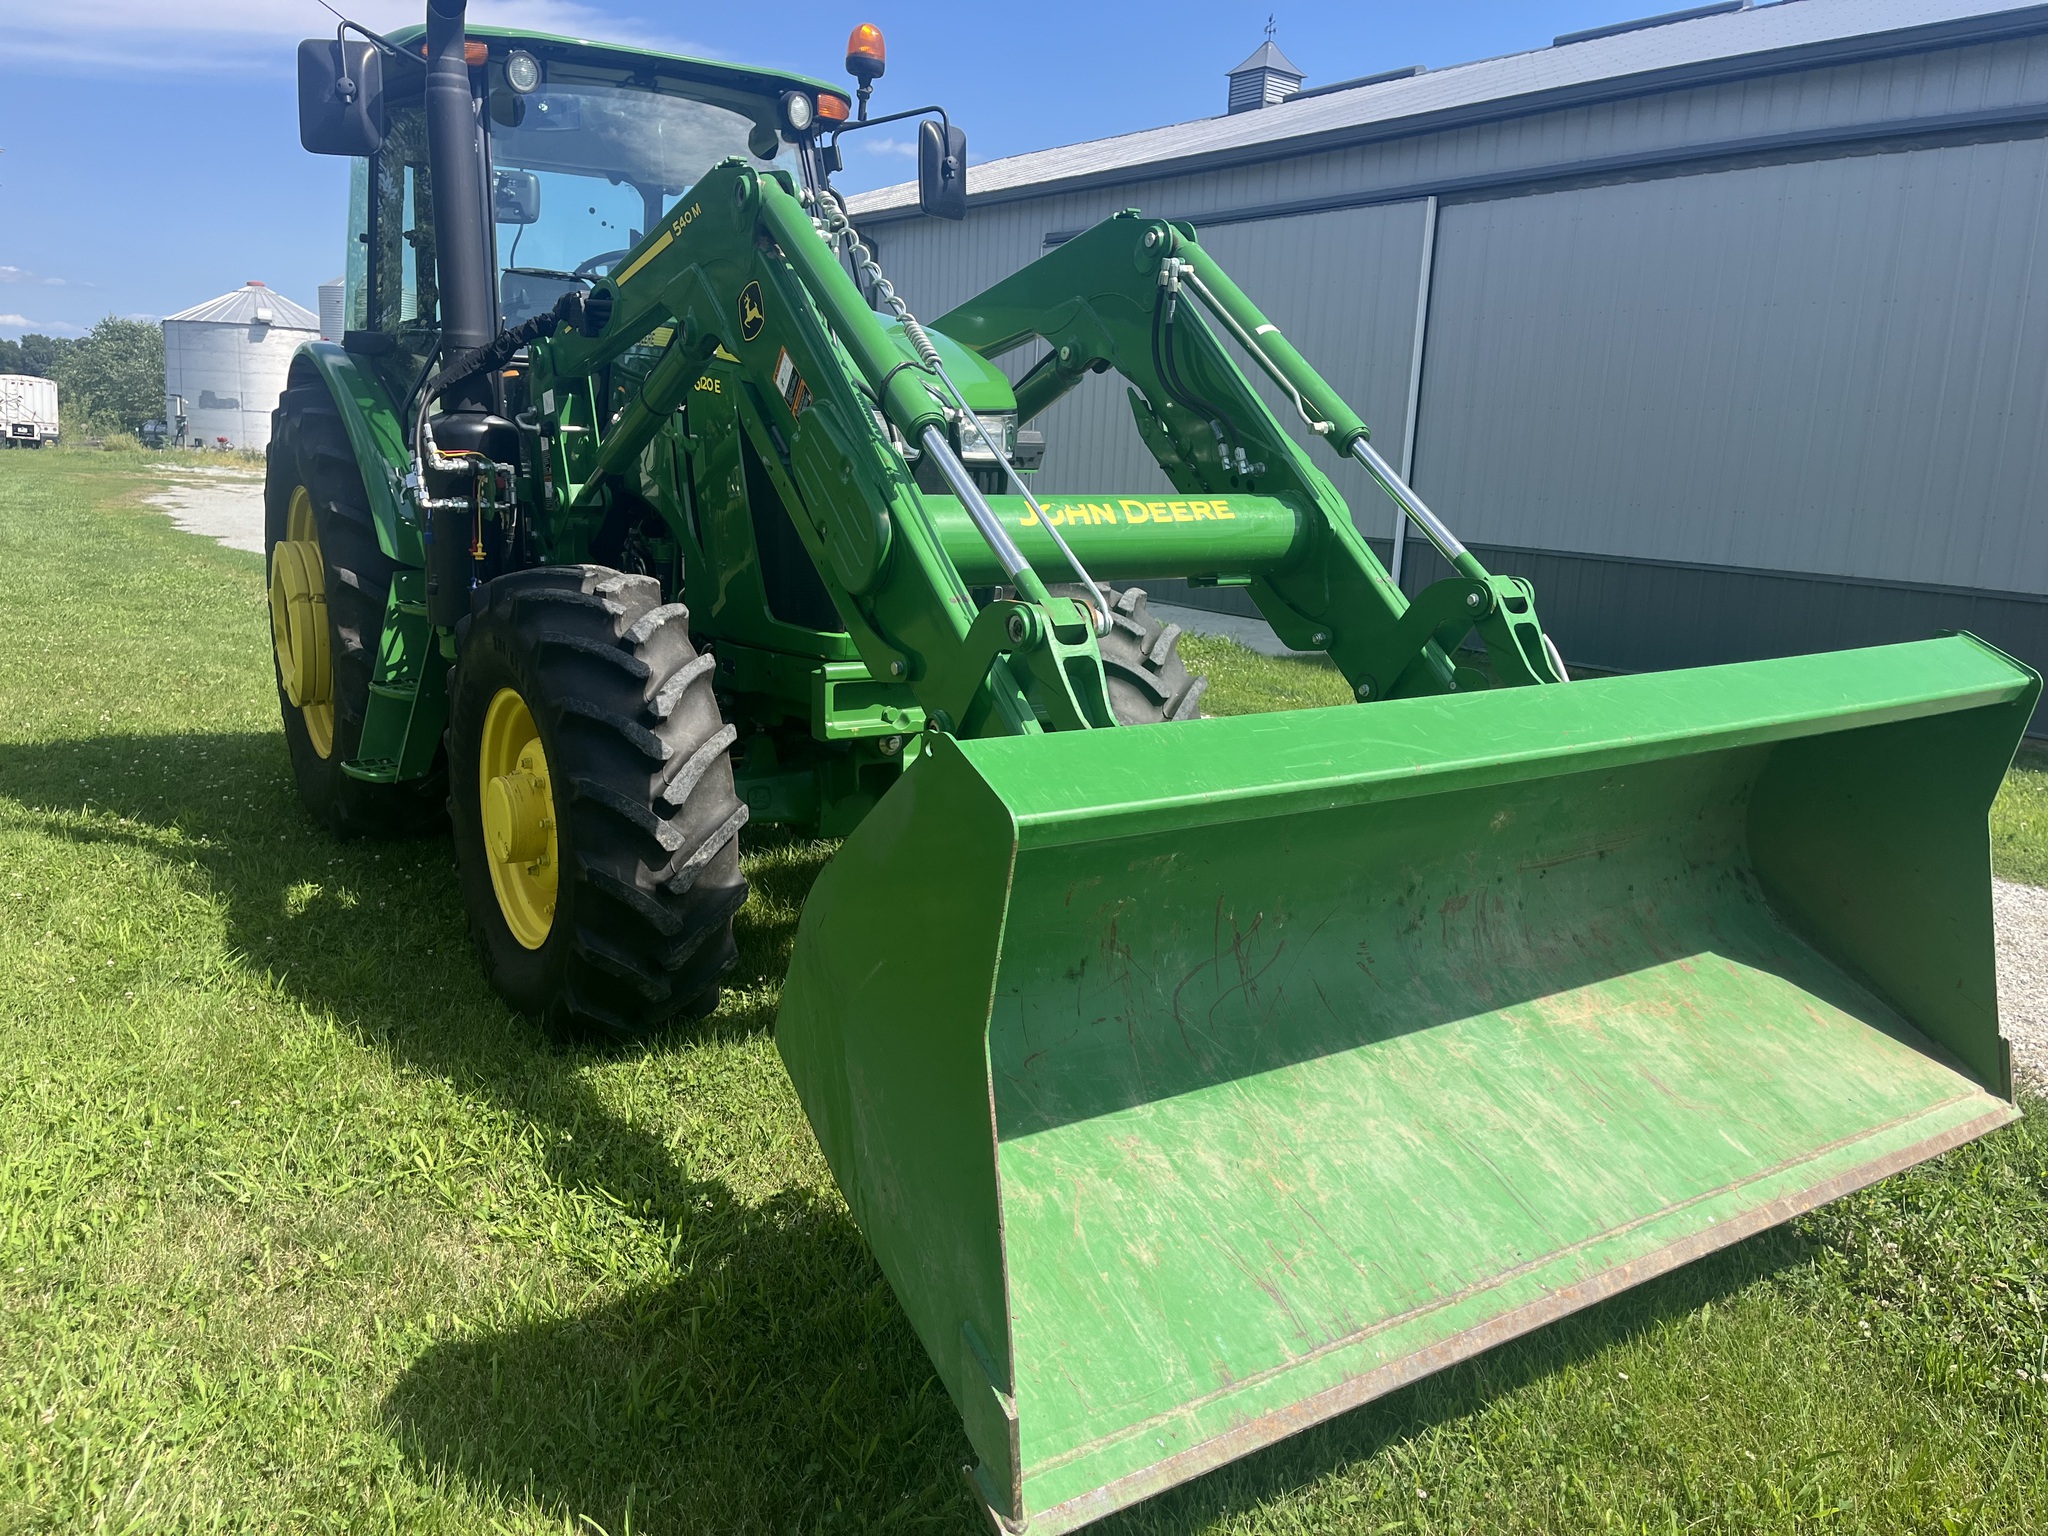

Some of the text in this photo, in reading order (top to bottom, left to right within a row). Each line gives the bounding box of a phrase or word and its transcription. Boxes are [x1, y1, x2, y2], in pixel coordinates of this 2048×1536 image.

[672, 202, 702, 237] 540 M
[714, 379, 721, 394] E
[1019, 499, 1236, 526] JOHN DEERE
